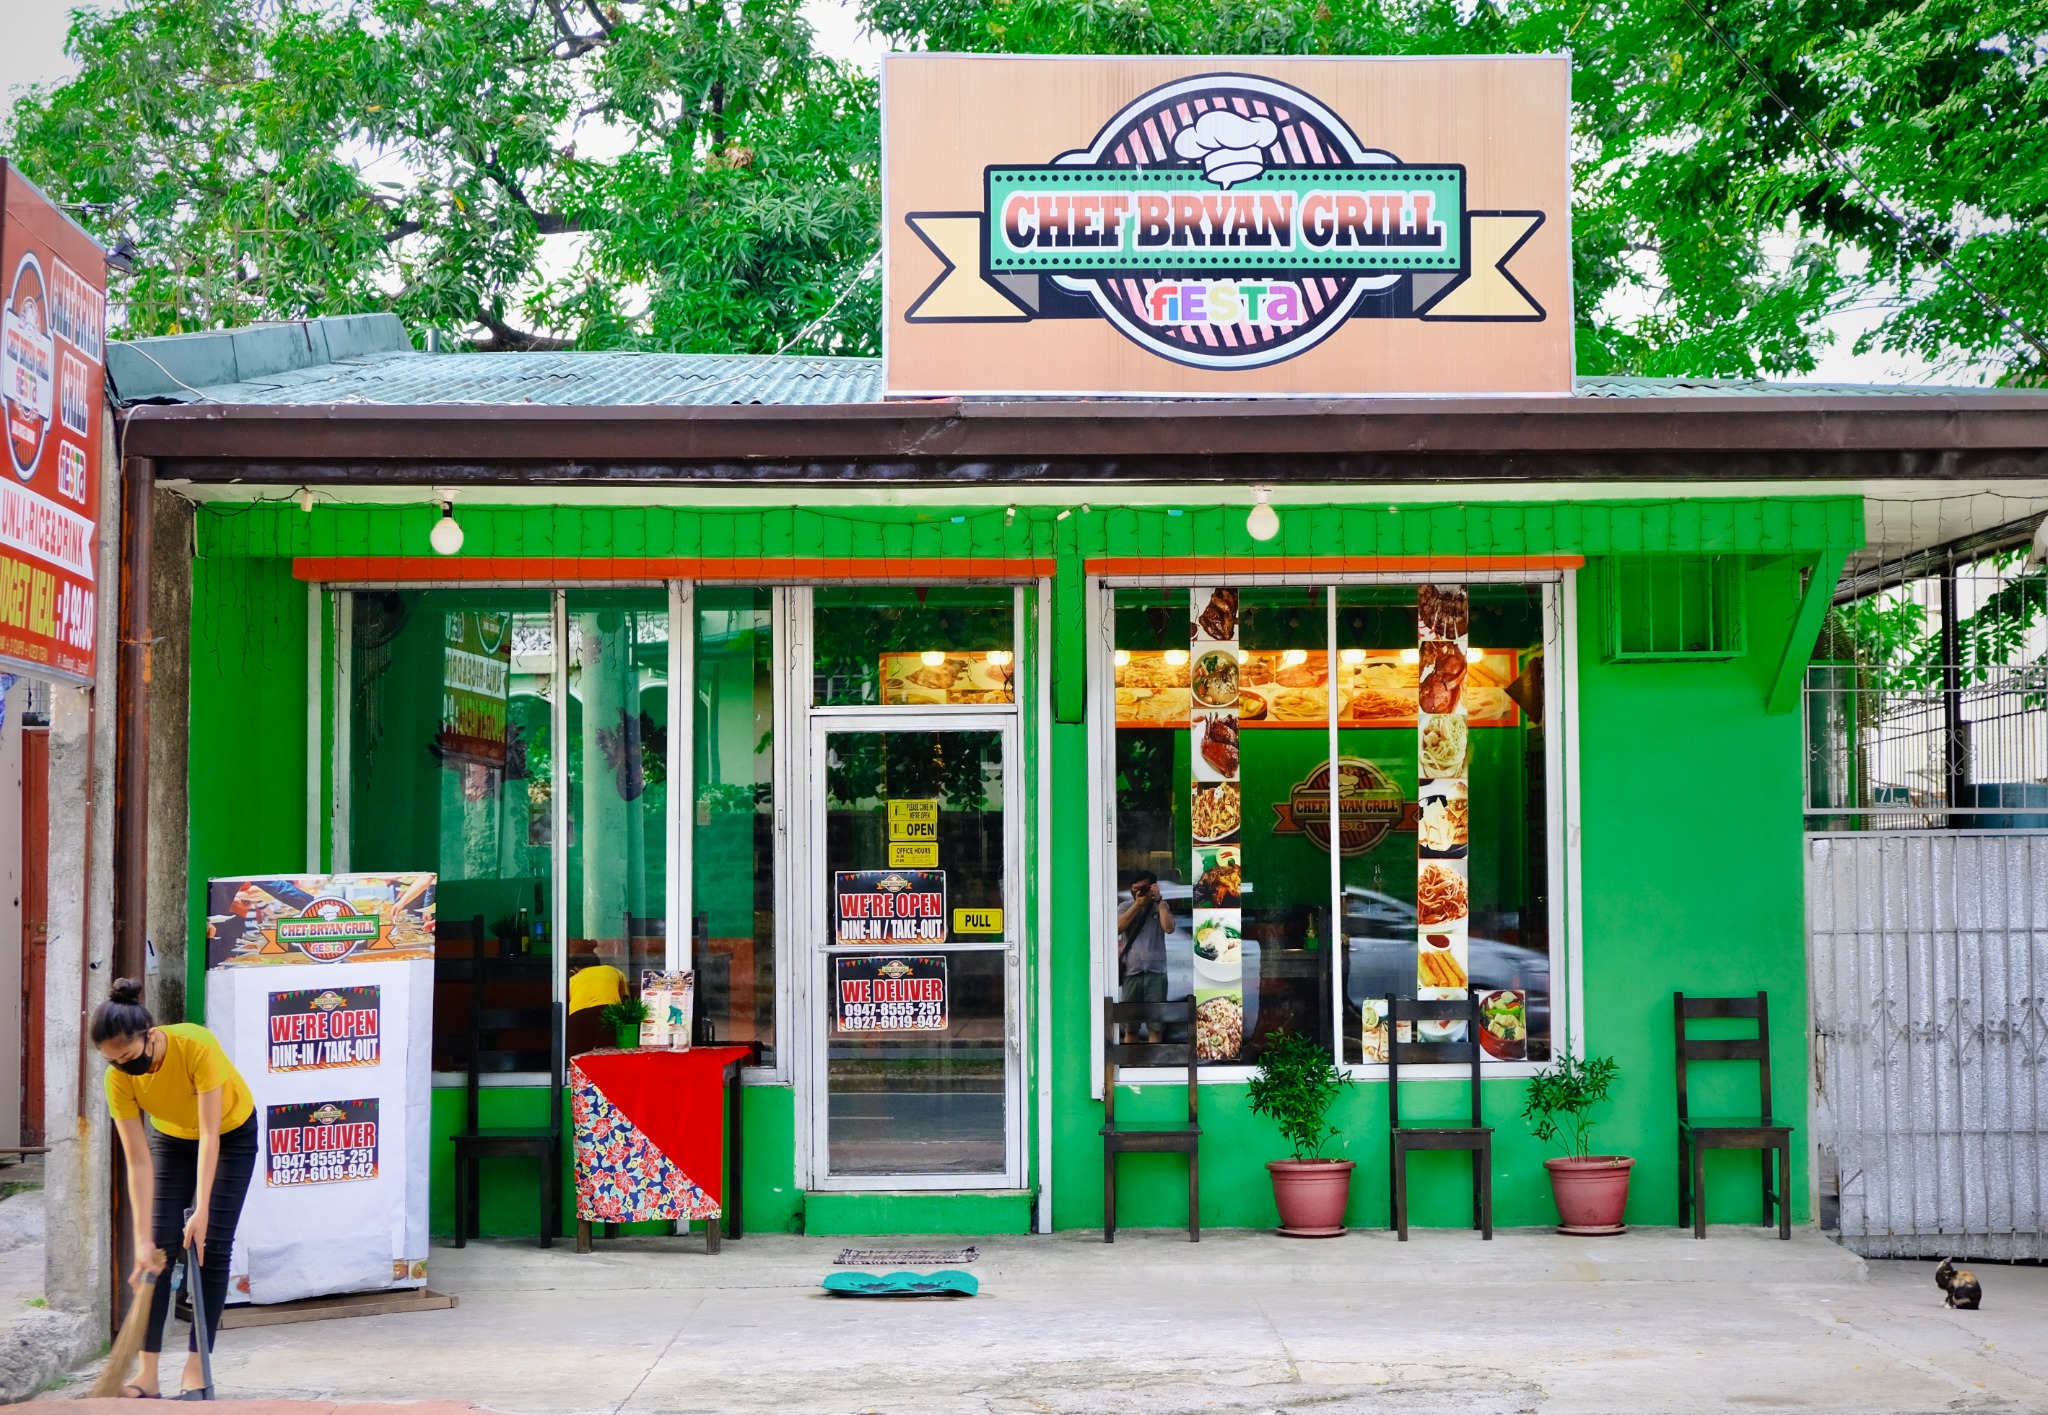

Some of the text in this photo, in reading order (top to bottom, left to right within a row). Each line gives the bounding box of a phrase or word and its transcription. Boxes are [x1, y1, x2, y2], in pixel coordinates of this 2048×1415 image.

[1003, 193, 1443, 248] CHEF BRYAN GRILL
[29, 567, 56, 639] MEAL
[906, 803, 919, 812] PLEASE
[1295, 799, 1326, 814] CHEF
[1365, 799, 1398, 813] GRILL
[906, 823, 935, 836] OPEN
[896, 847, 931, 855] OFFICE HOURS
[840, 892, 942, 918] WE'RE OPEN
[281, 920, 375, 938] CHEF BRYAN GRILL
[841, 920, 881, 940] DINE-IN
[890, 919, 943, 939] TAKE-OUT
[965, 914, 991, 928] PULL
[841, 978, 944, 1004] WE DELIVER
[844, 1002, 941, 1017] 0947-8555-251
[271, 1009, 377, 1043] WE'RE OPEN
[845, 1015, 942, 1030] 0927-6019-942
[272, 1042, 315, 1068] DINE-IN
[324, 1038, 378, 1064] TAKE-OUT
[269, 1121, 376, 1155] WE DELIVER
[272, 1148, 374, 1170] 0947-8555-251
[272, 1162, 374, 1185] 0927-6019-942
